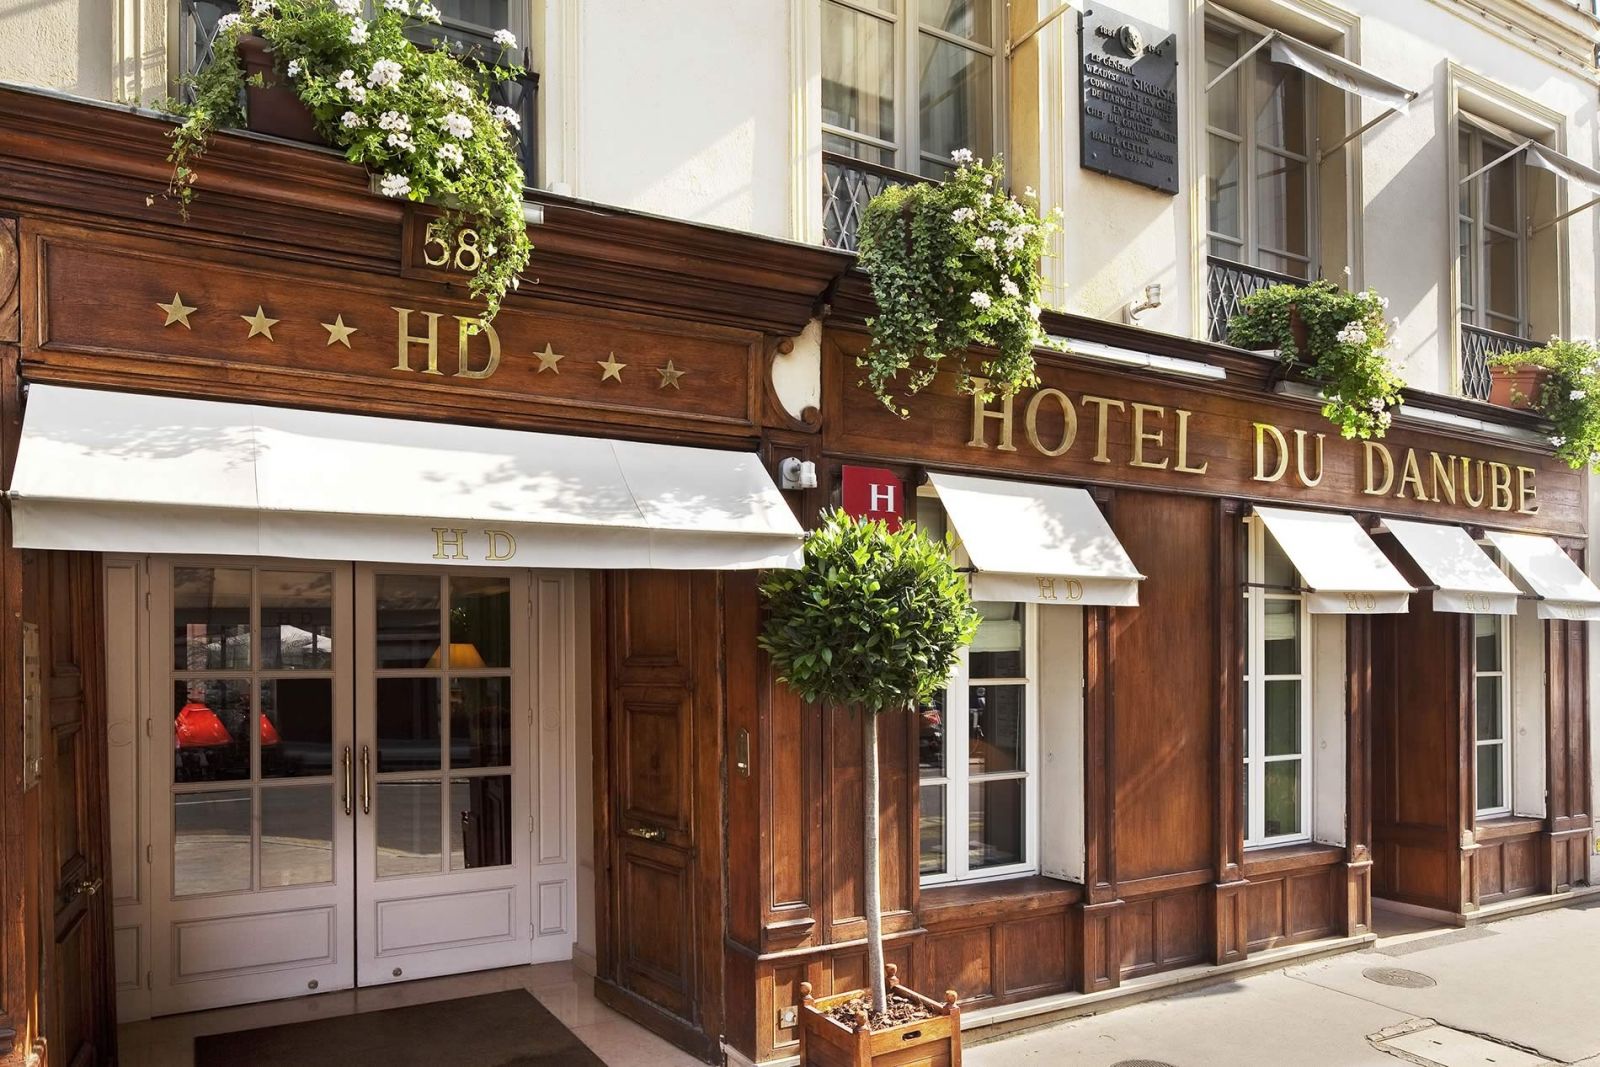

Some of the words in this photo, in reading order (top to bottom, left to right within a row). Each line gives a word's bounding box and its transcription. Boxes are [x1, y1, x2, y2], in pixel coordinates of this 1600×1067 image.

[1091, 88, 1100, 97] DE
[1133, 77, 1176, 103] SIKORSKI
[1086, 106, 1105, 119] CHEF
[1109, 113, 1118, 123] DU
[1113, 105, 1122, 115] EN
[1091, 130, 1119, 145] HABITA
[424, 223, 480, 271] 58
[391, 307, 502, 379] HD
[967, 376, 1208, 475] HOTEL
[1252, 422, 1325, 487] DU
[1362, 440, 1539, 515] DANUBE
[868, 483, 897, 513] H
